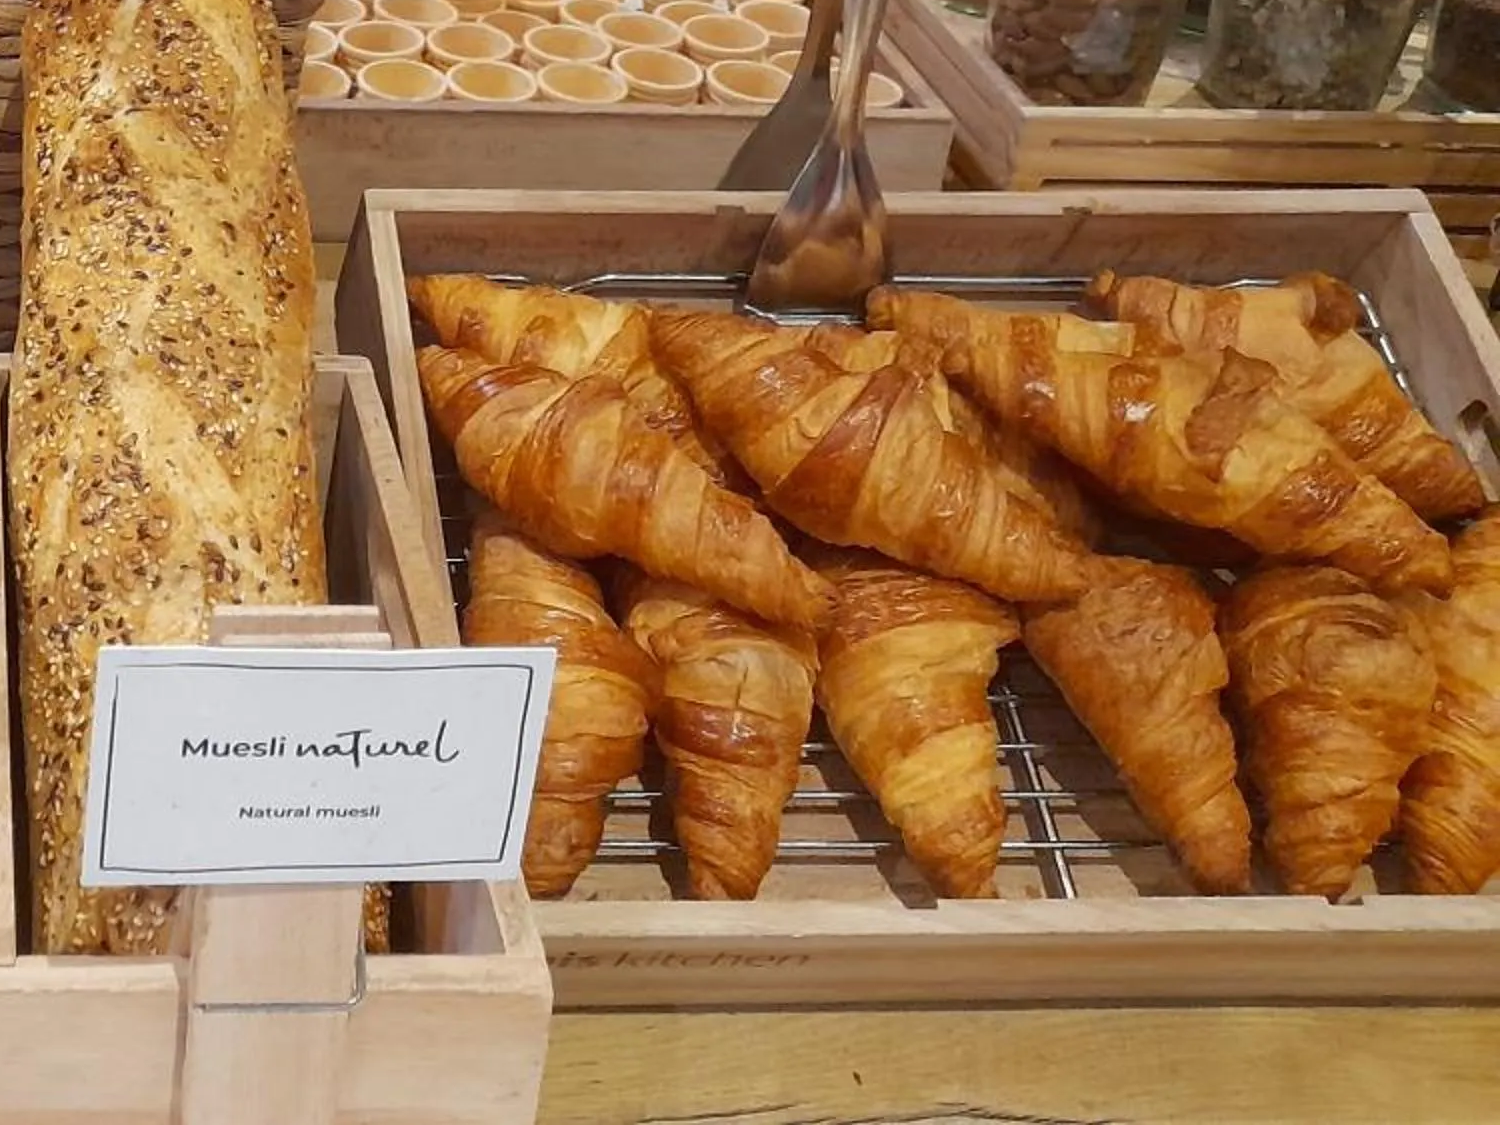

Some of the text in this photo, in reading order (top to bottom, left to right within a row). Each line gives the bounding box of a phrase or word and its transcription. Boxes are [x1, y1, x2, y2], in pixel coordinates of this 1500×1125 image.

[181, 736, 287, 759] Muesli
[238, 805, 381, 819] Natural muesli
[613, 951, 811, 968] kitchen
